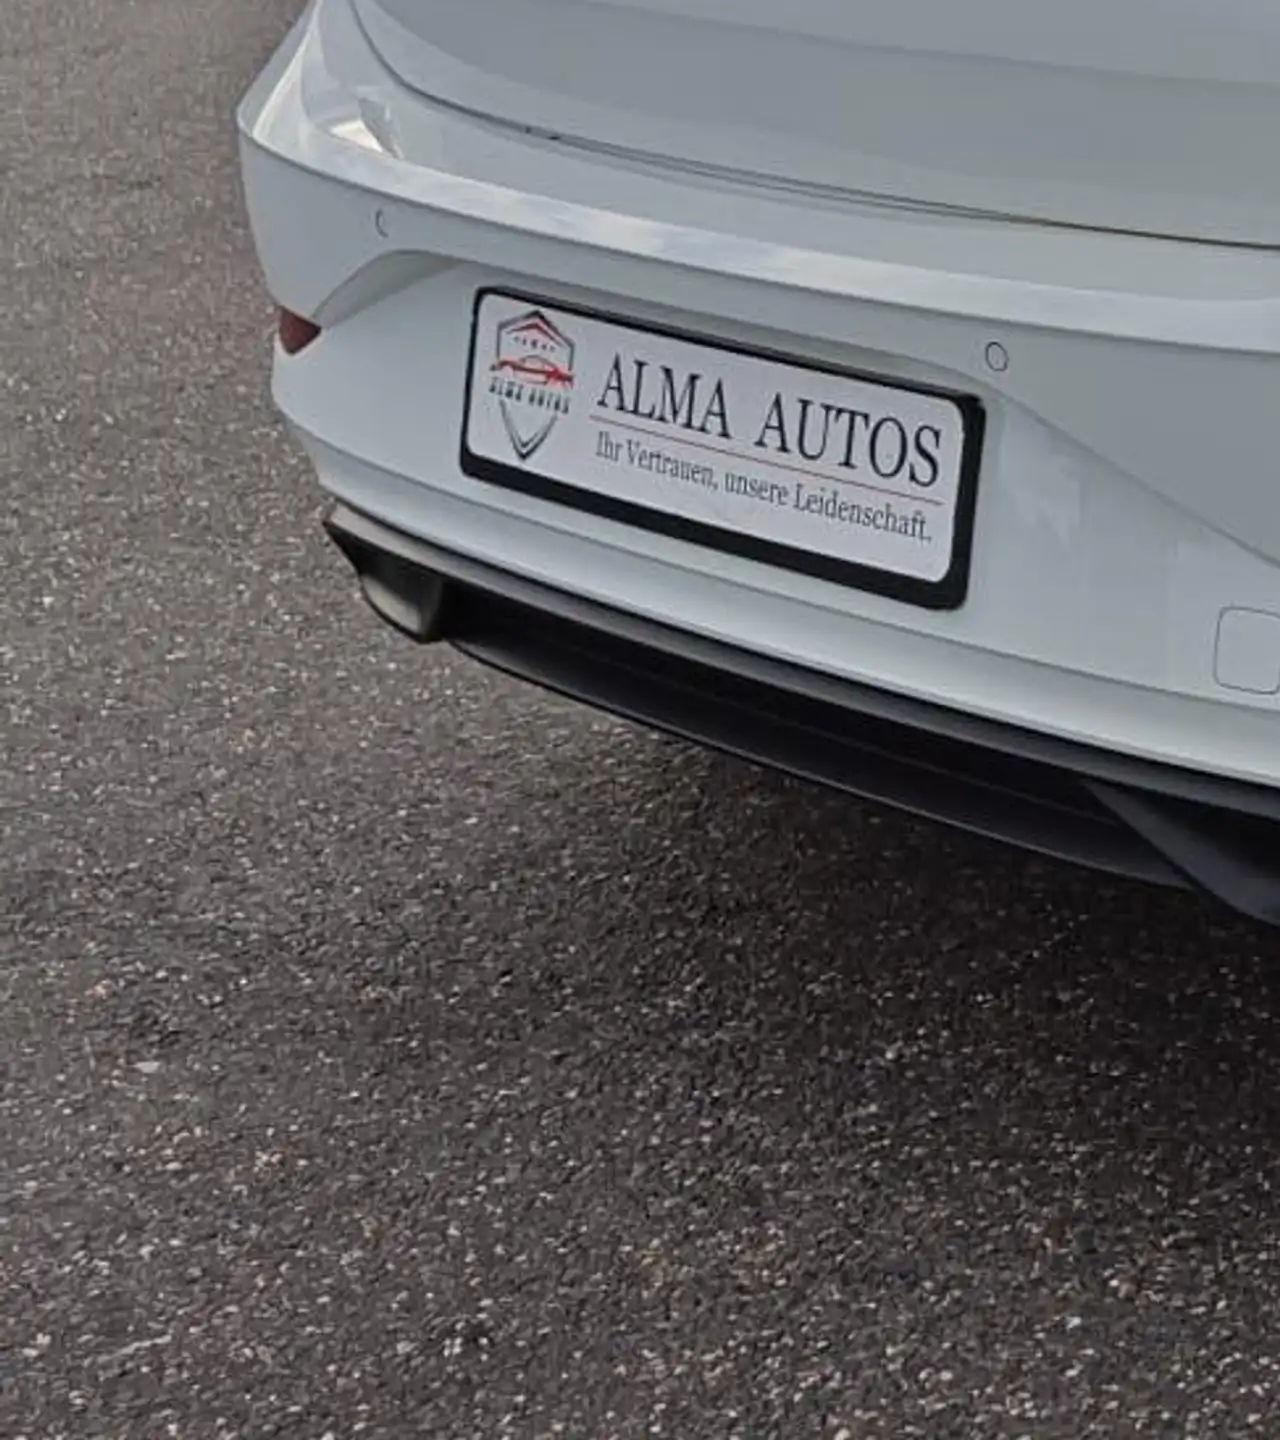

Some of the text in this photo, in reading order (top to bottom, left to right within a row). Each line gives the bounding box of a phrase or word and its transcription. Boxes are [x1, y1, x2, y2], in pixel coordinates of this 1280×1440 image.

[596, 352, 943, 487] ALMA AUTOS
[595, 429, 934, 541] Ihr Vertrauen, unsere Leidenschaft.
